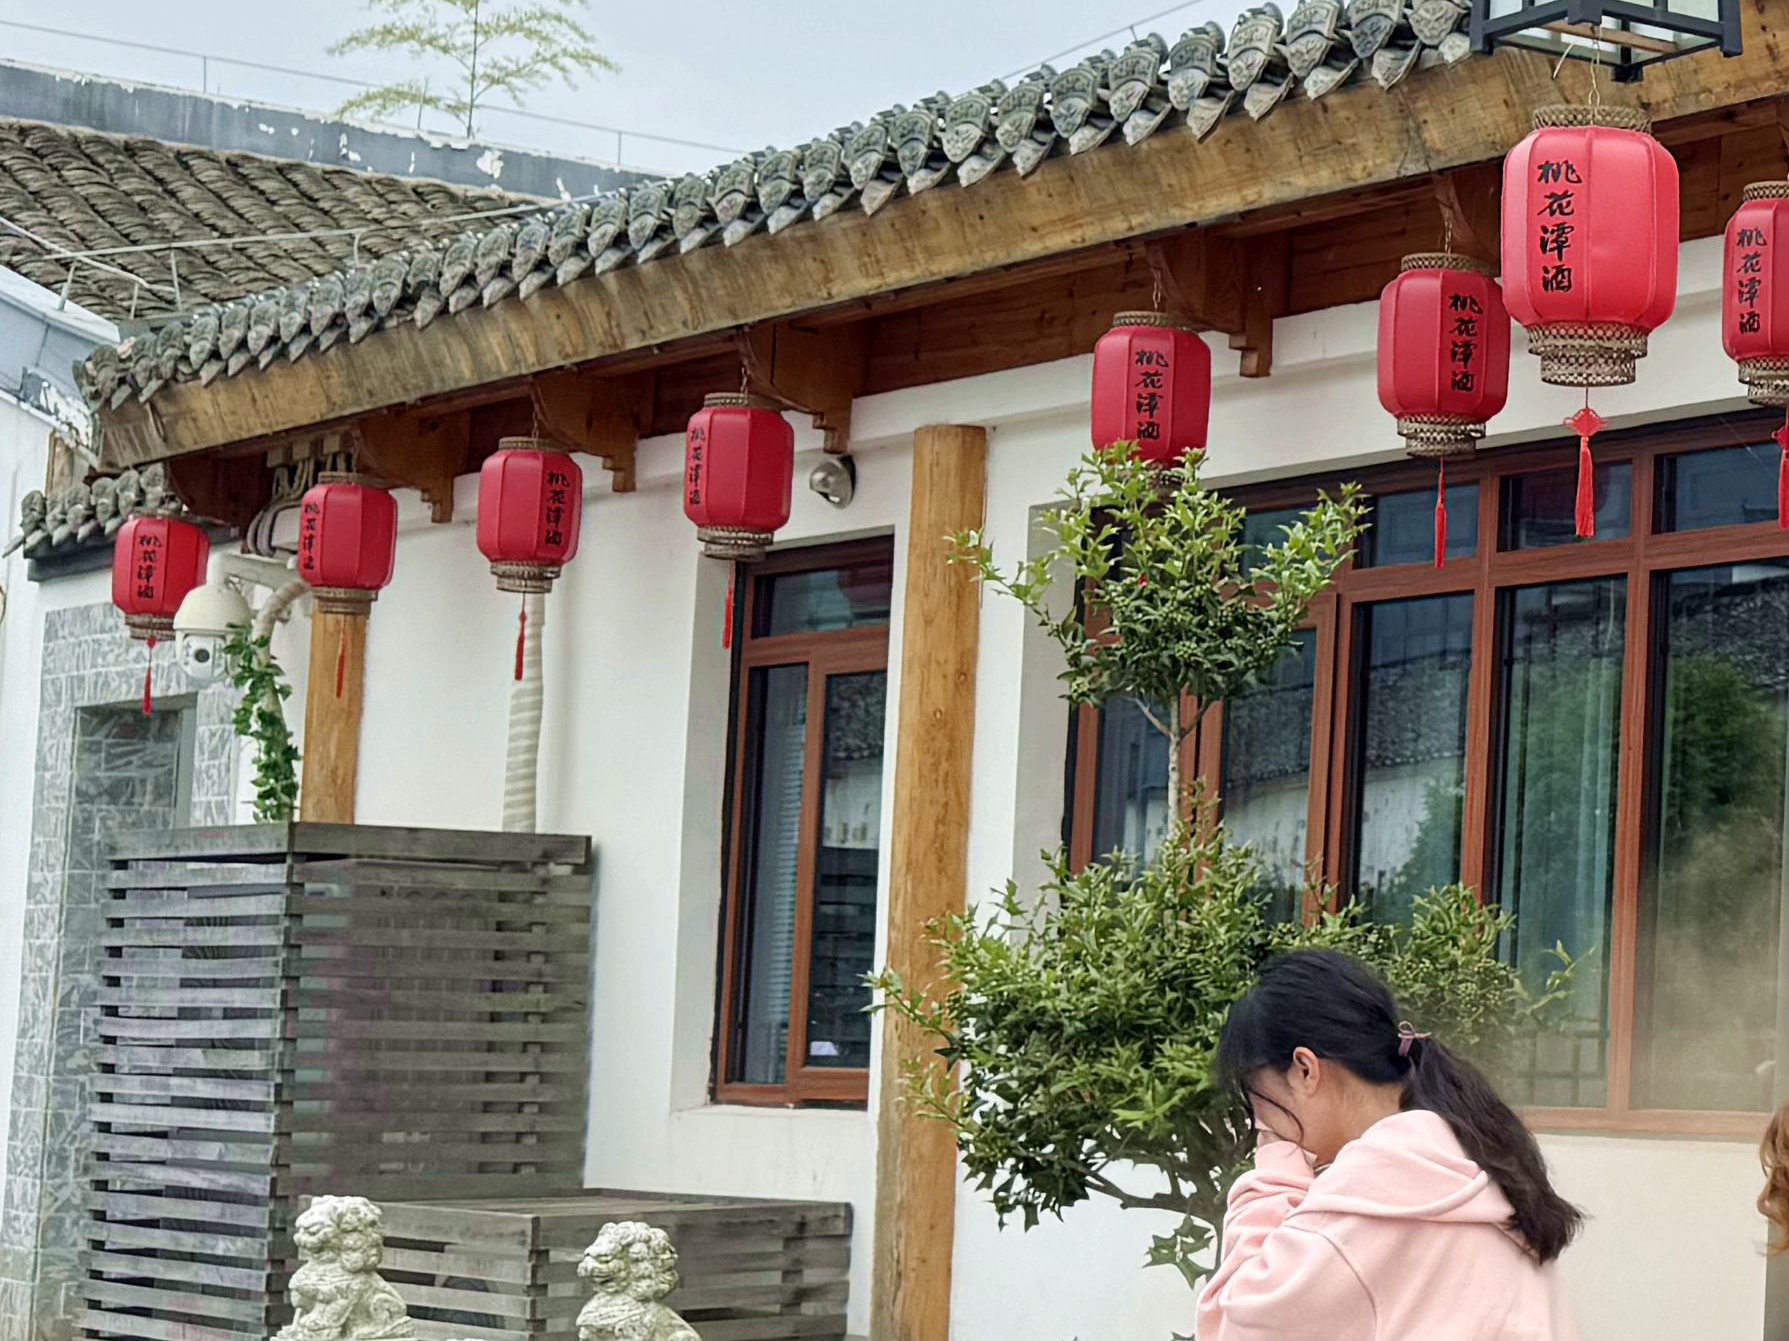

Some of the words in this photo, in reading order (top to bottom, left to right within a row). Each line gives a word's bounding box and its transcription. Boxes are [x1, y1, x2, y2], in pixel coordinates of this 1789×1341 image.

[1537, 159, 1583, 295] 桃花潭酒
[1736, 226, 1768, 336] 桃花潭酒
[1134, 348, 1169, 442] 桃花潭酒
[1448, 292, 1484, 394] 桃花潭酒
